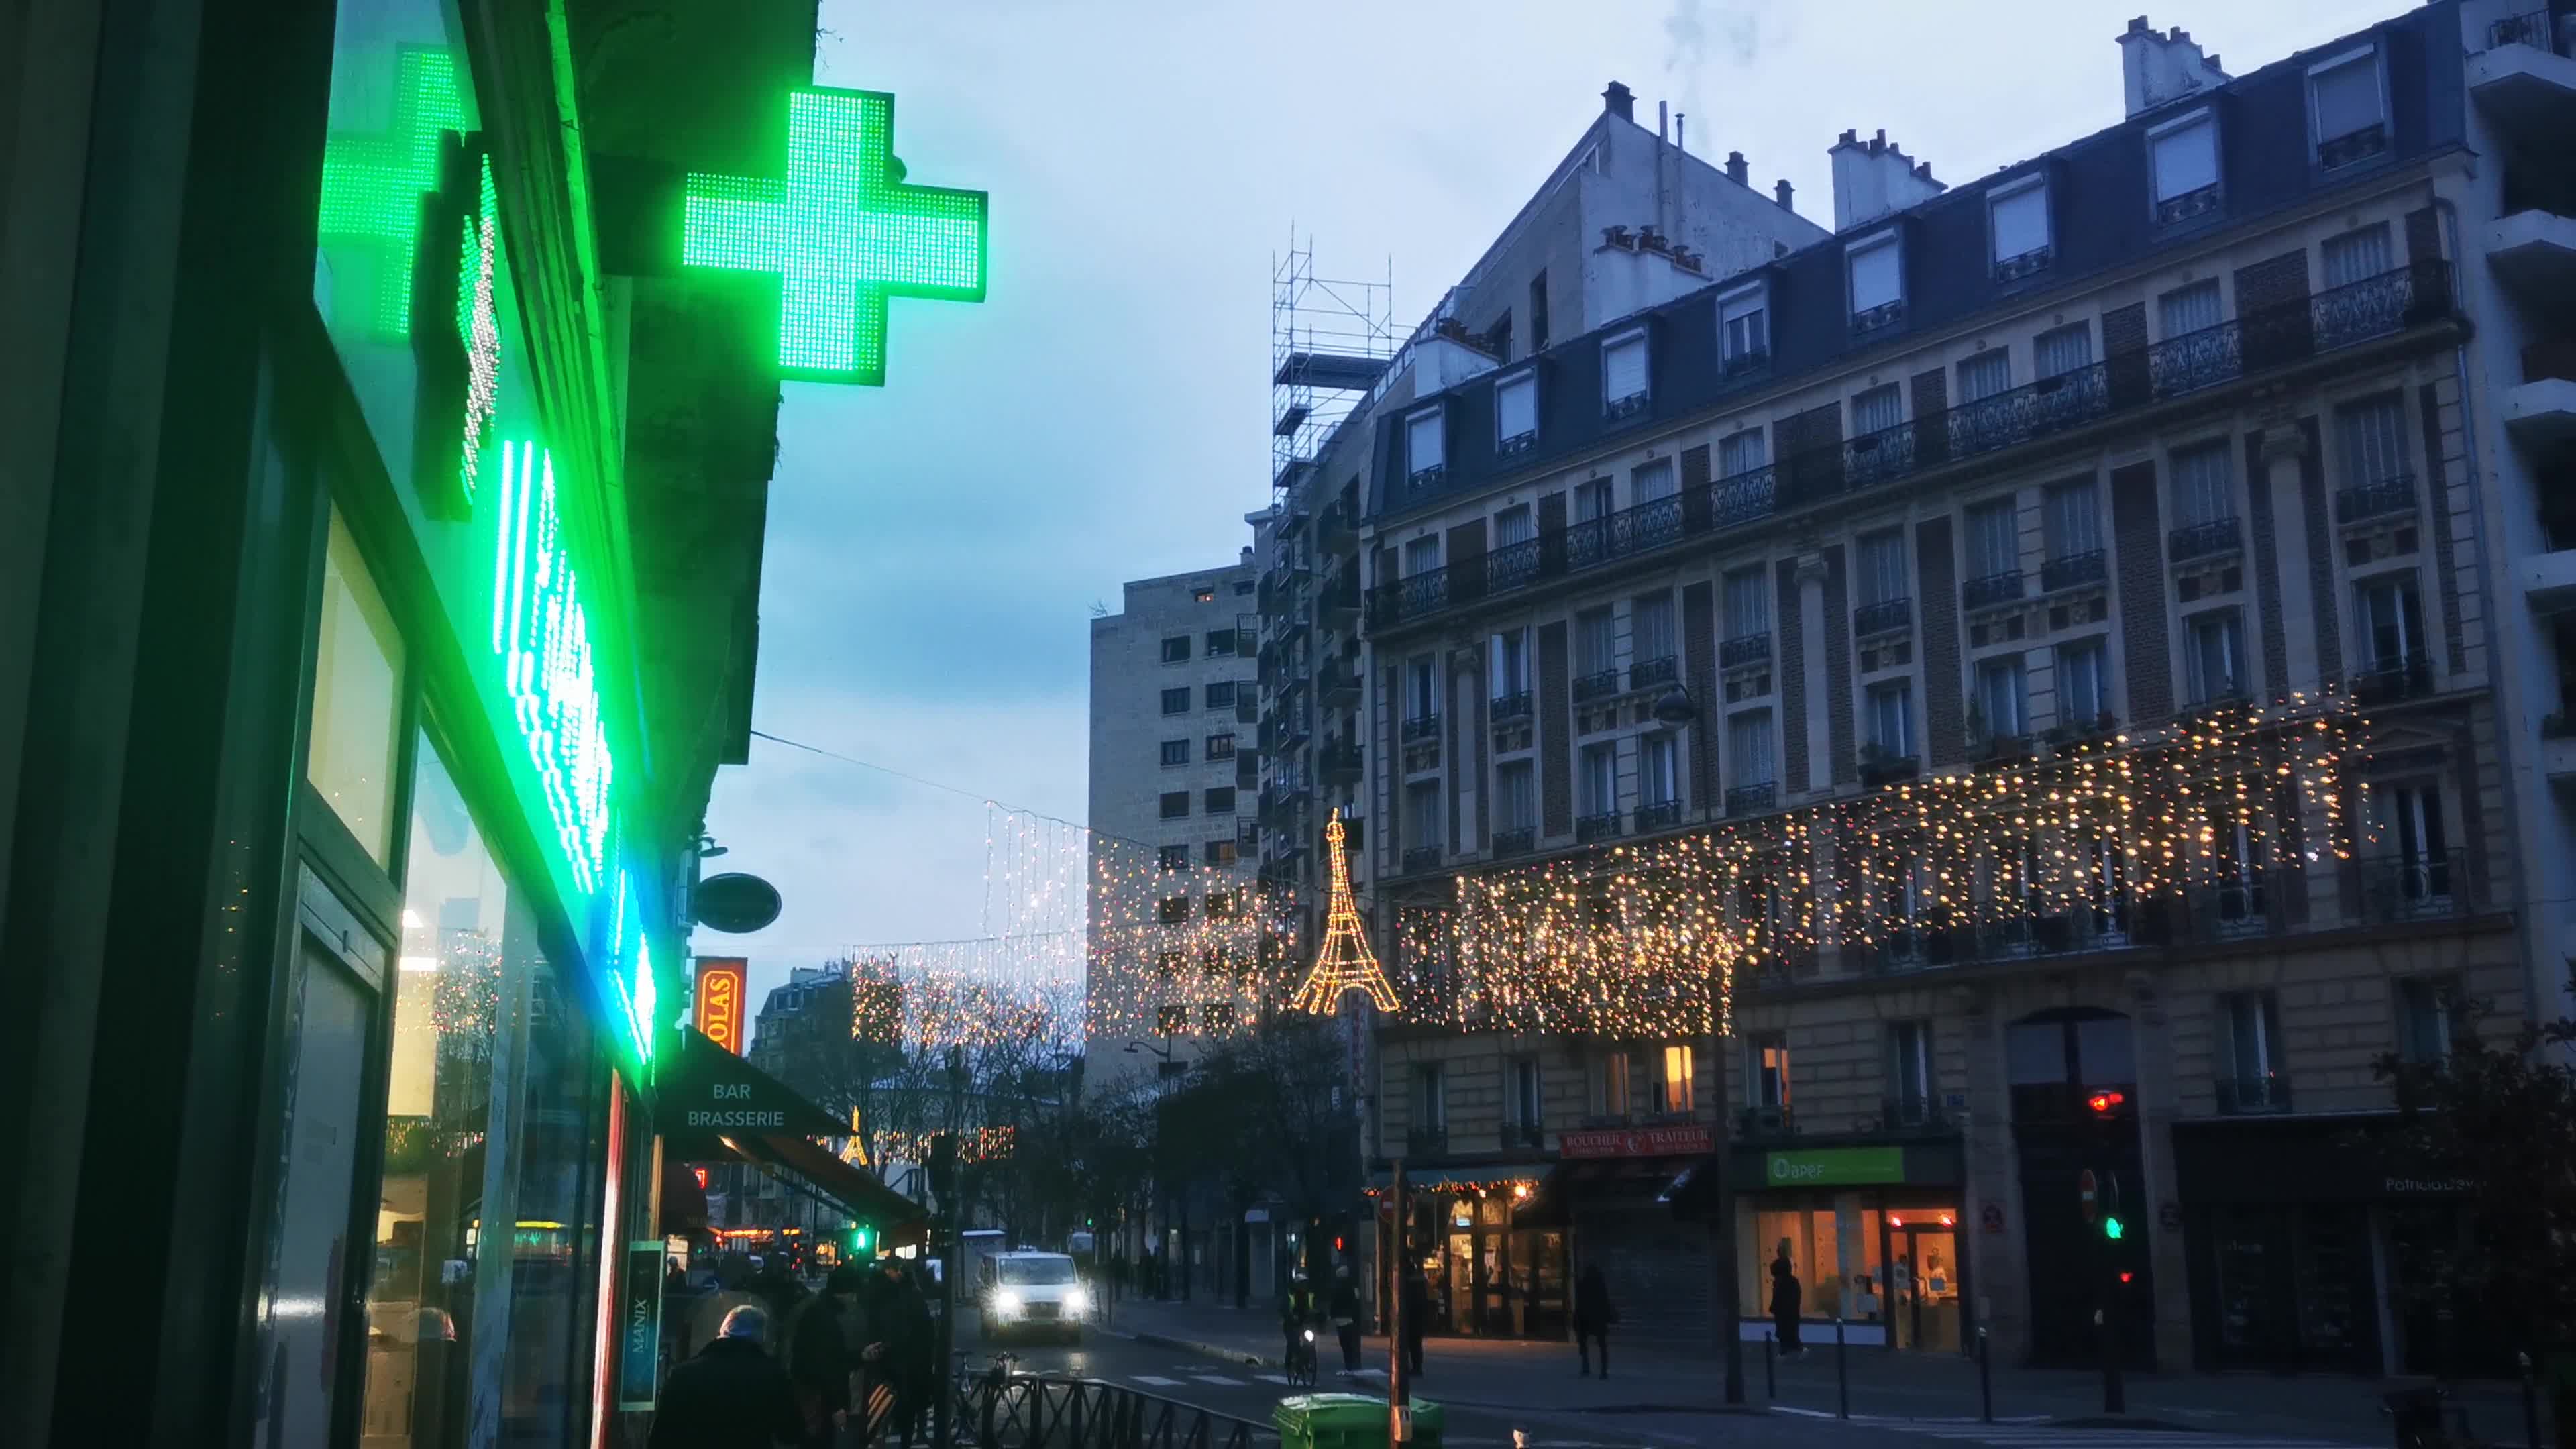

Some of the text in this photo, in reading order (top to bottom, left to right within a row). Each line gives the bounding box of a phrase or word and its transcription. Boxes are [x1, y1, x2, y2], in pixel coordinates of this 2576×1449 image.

[707, 977, 731, 1045] OLAS
[714, 1084, 752, 1099] BAR
[688, 1110, 784, 1127] BRASSERIE
[1566, 1128, 1708, 1147] BOUCHER TRAITEUR
[632, 1299, 648, 1353] MANIX
